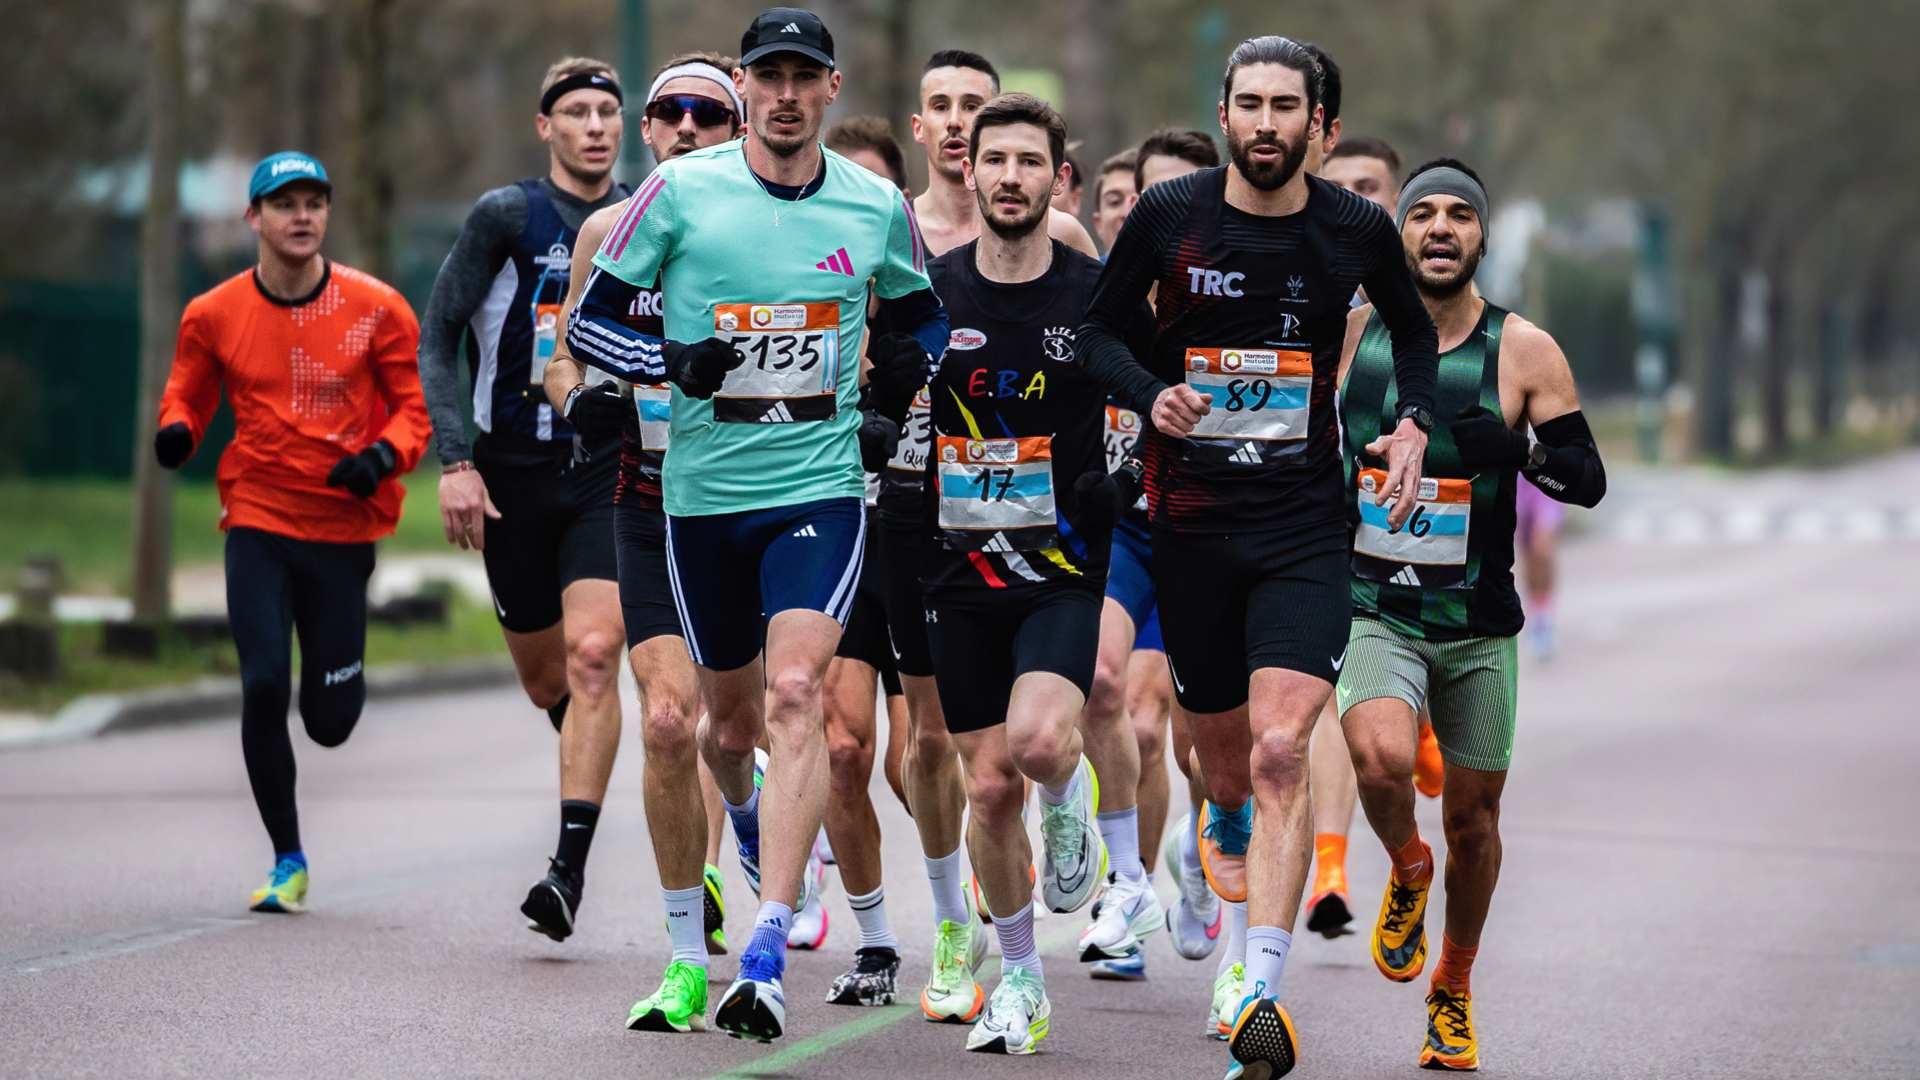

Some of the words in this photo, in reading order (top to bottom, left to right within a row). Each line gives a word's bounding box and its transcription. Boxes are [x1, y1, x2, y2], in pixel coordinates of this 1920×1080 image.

[271, 159, 319, 177] HOKA
[1187, 266, 1246, 298] TRC
[1044, 326, 1076, 341] ALTEA
[728, 334, 823, 372] 5135
[1225, 378, 1272, 412] 89
[974, 467, 1016, 502] 17
[1388, 504, 1431, 538] 6
[325, 659, 362, 686] HOKA
[1262, 947, 1281, 958] RUN
